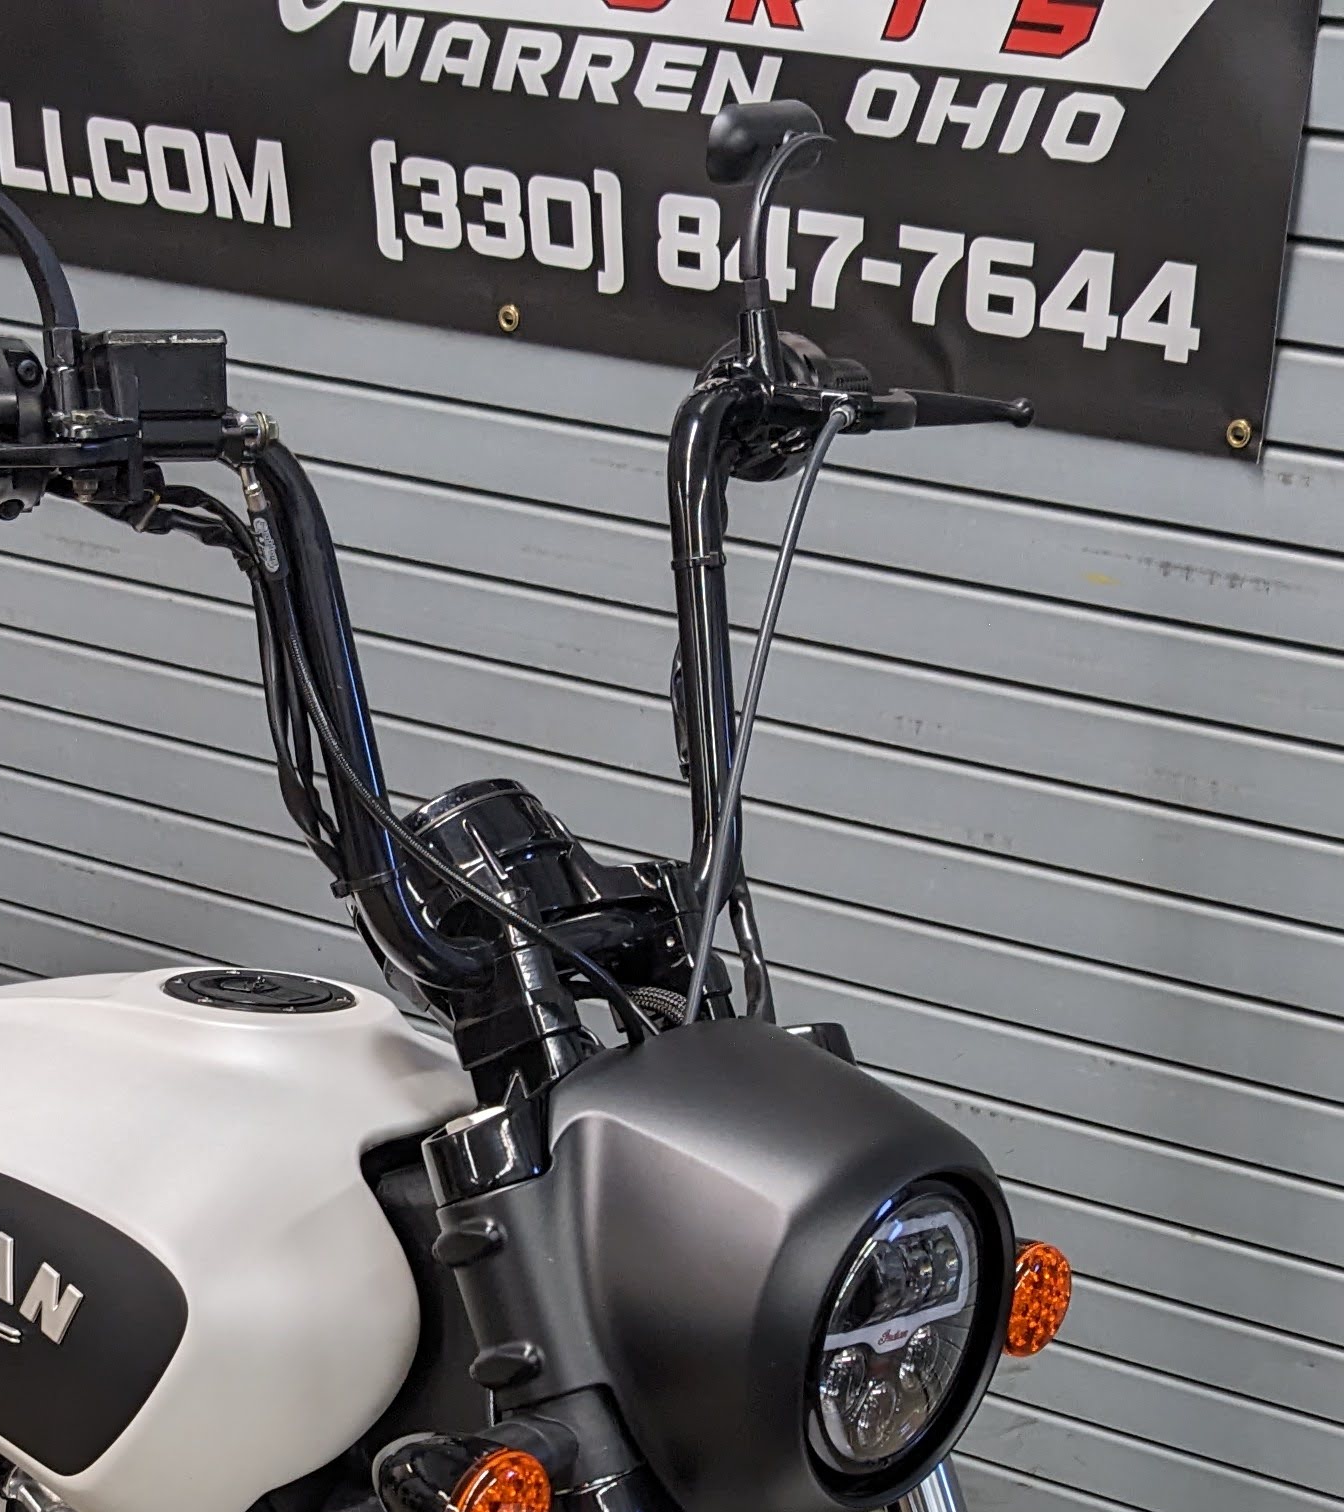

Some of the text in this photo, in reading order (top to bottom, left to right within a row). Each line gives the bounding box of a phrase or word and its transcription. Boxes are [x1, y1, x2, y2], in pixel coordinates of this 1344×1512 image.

[347, 10, 781, 116] WARREN
[845, 70, 1126, 164] OHIO
[370, 138, 1201, 362] (330) 847-7644
